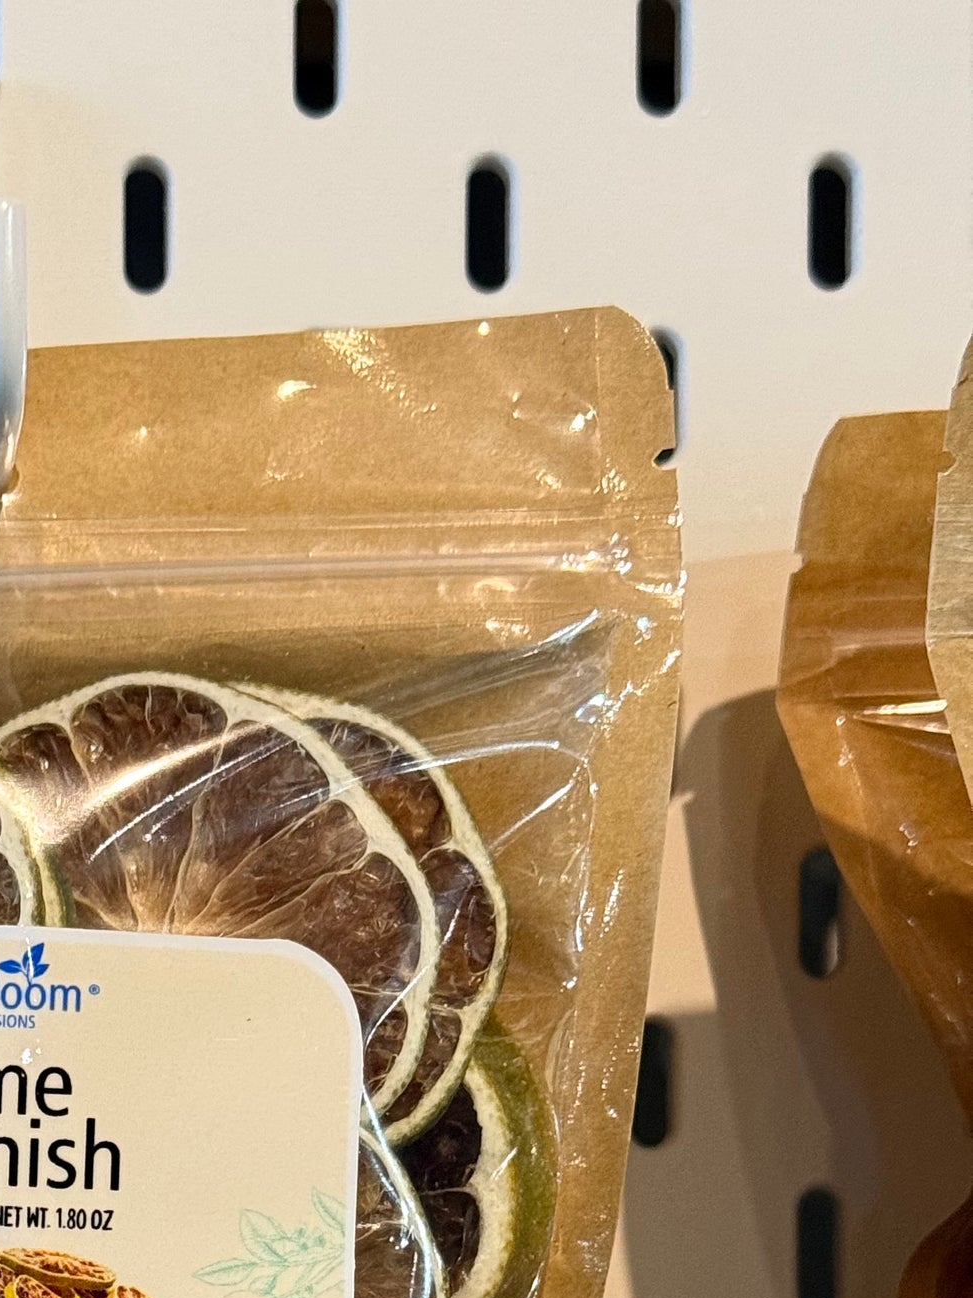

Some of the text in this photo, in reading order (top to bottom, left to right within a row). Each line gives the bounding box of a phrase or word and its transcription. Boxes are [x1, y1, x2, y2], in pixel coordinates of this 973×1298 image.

[27, 1206, 51, 1229] WT.
[55, 1207, 88, 1230] 1.80
[90, 1209, 114, 1231] OZ
